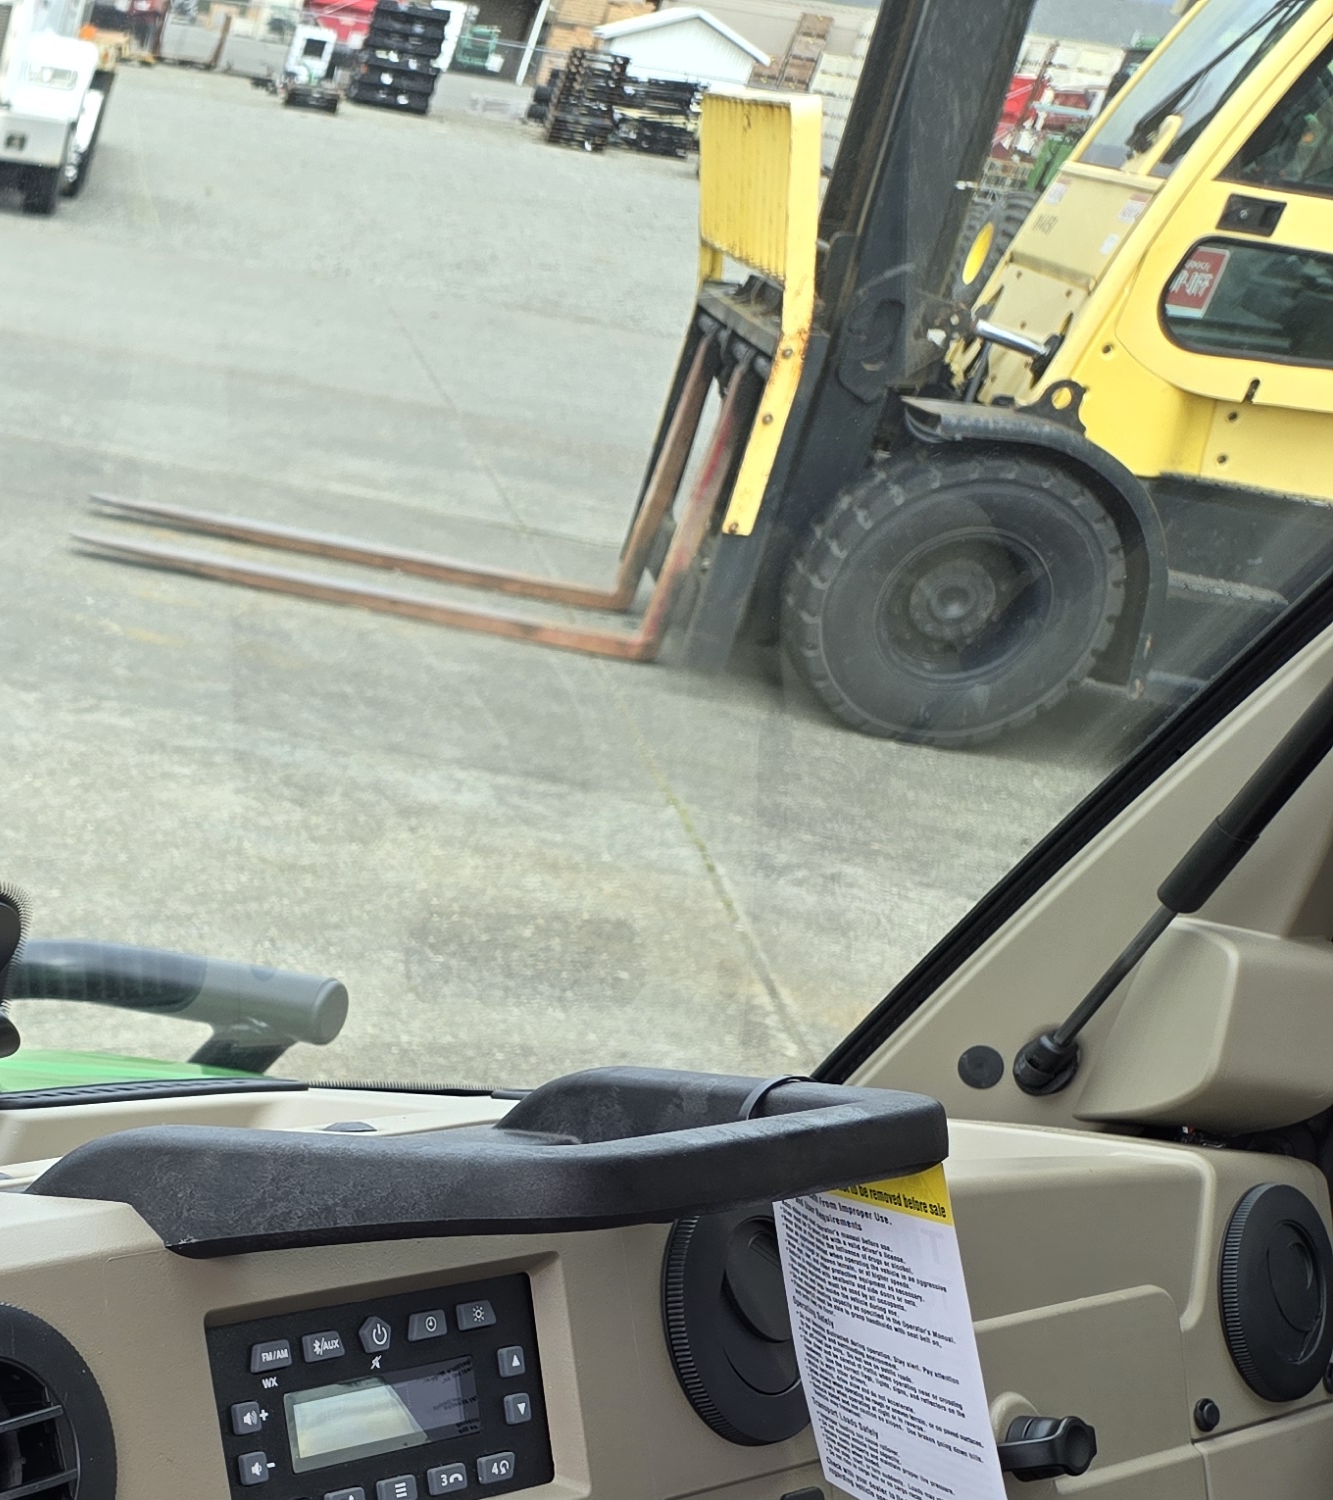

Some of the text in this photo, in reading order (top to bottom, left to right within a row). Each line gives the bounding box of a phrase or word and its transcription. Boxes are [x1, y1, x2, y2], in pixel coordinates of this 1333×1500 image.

[870, 1188, 902, 1207] removed
[903, 1196, 928, 1213] before
[929, 1203, 946, 1218] sale
[261, 1348, 289, 1363] FM/AM
[262, 1376, 278, 1389] WX
[440, 1474, 448, 1486] 3
[491, 1461, 499, 1474] 4
